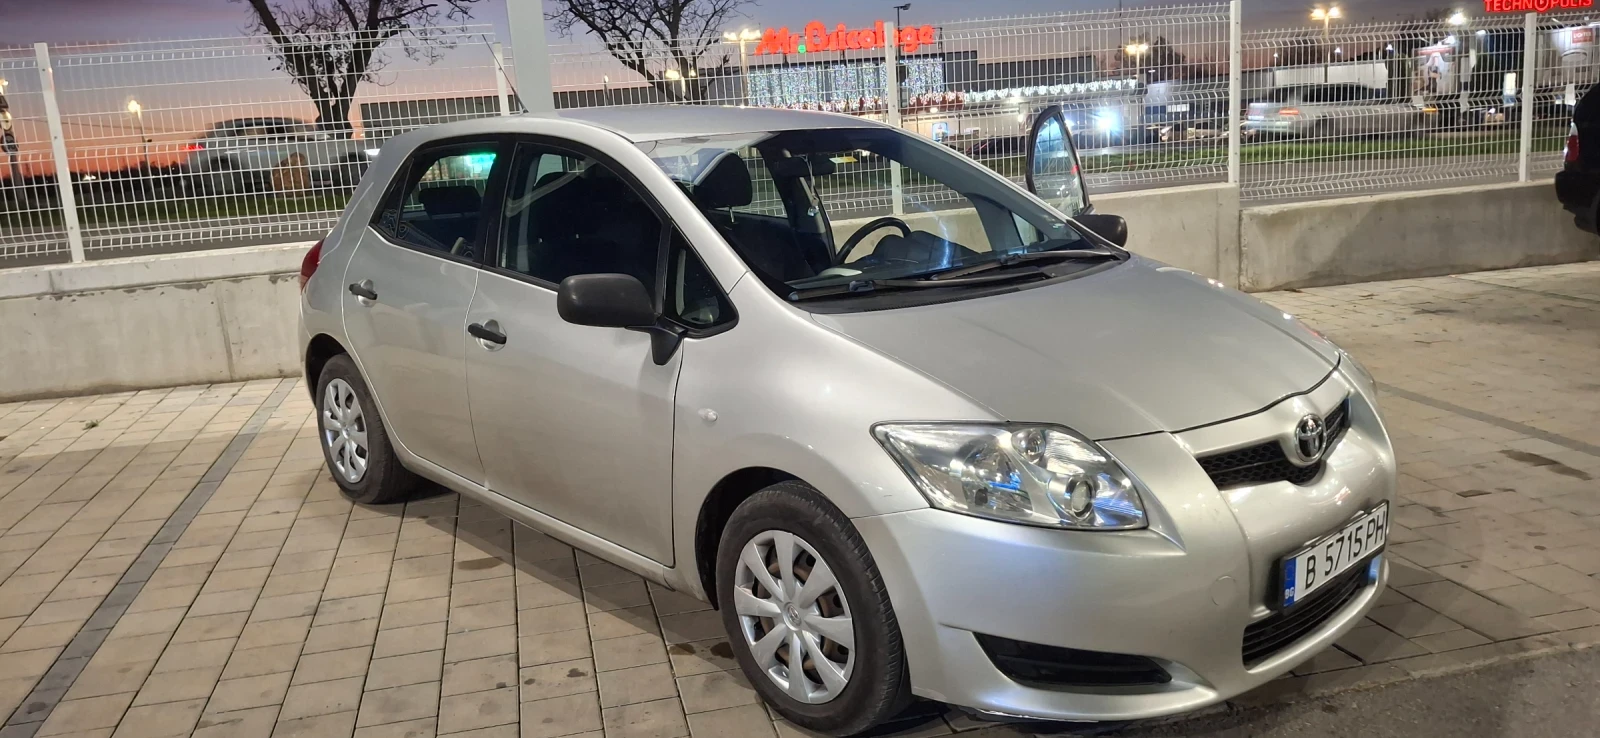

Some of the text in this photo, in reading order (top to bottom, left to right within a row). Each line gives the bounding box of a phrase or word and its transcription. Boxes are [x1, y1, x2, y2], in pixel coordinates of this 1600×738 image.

[1484, 0, 1593, 11] TECHNOPOLIS
[1305, 554, 1317, 590] B
[1284, 586, 1295, 600] BG
